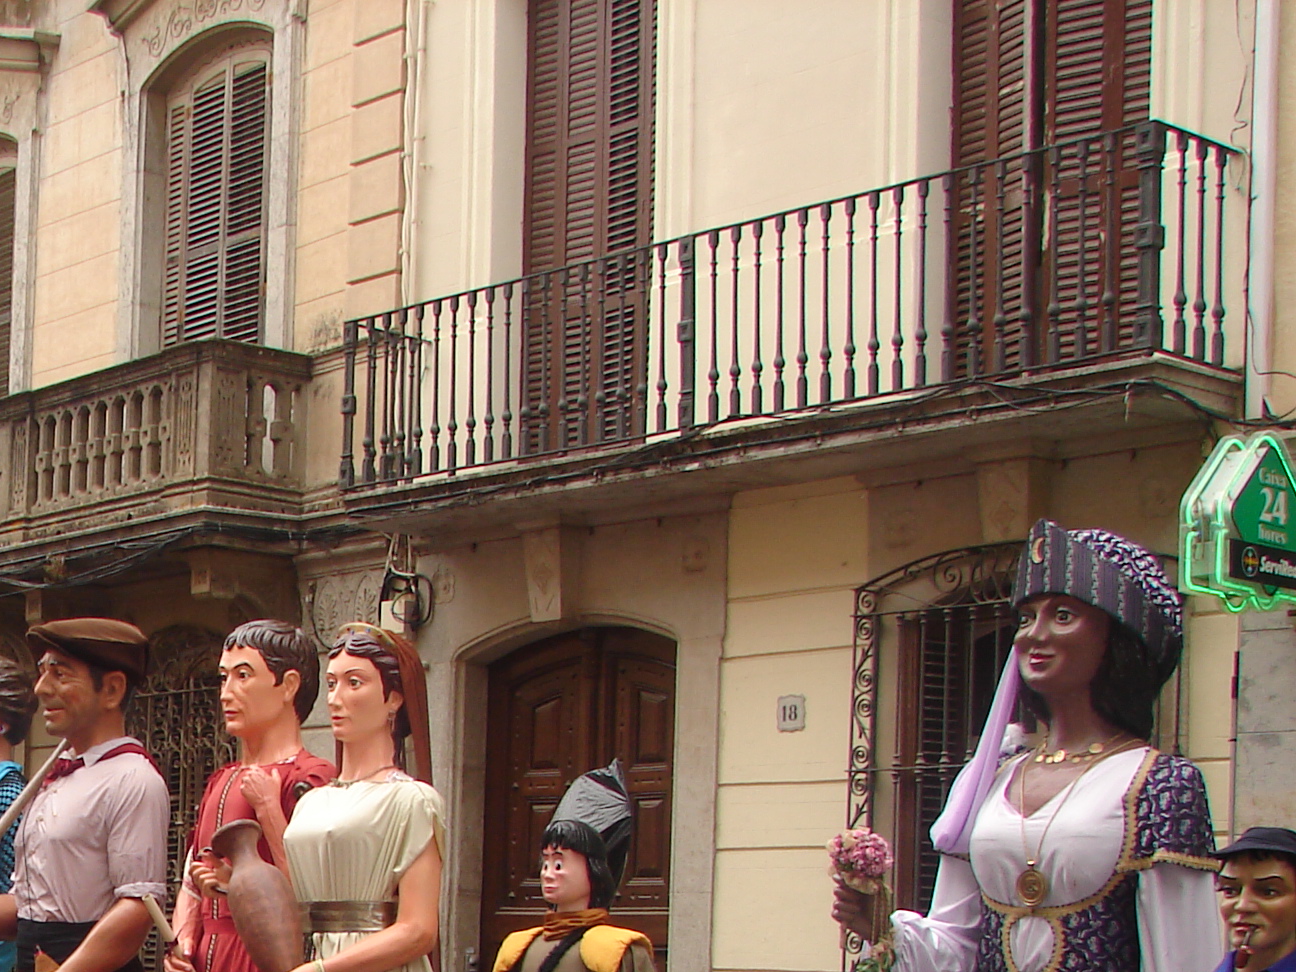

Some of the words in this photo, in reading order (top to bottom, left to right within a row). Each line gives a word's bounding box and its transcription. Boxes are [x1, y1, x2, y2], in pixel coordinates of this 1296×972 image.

[1259, 466, 1289, 488] Caixa
[1259, 486, 1289, 526] 24
[1258, 522, 1288, 545] hores
[782, 704, 798, 722] 18
